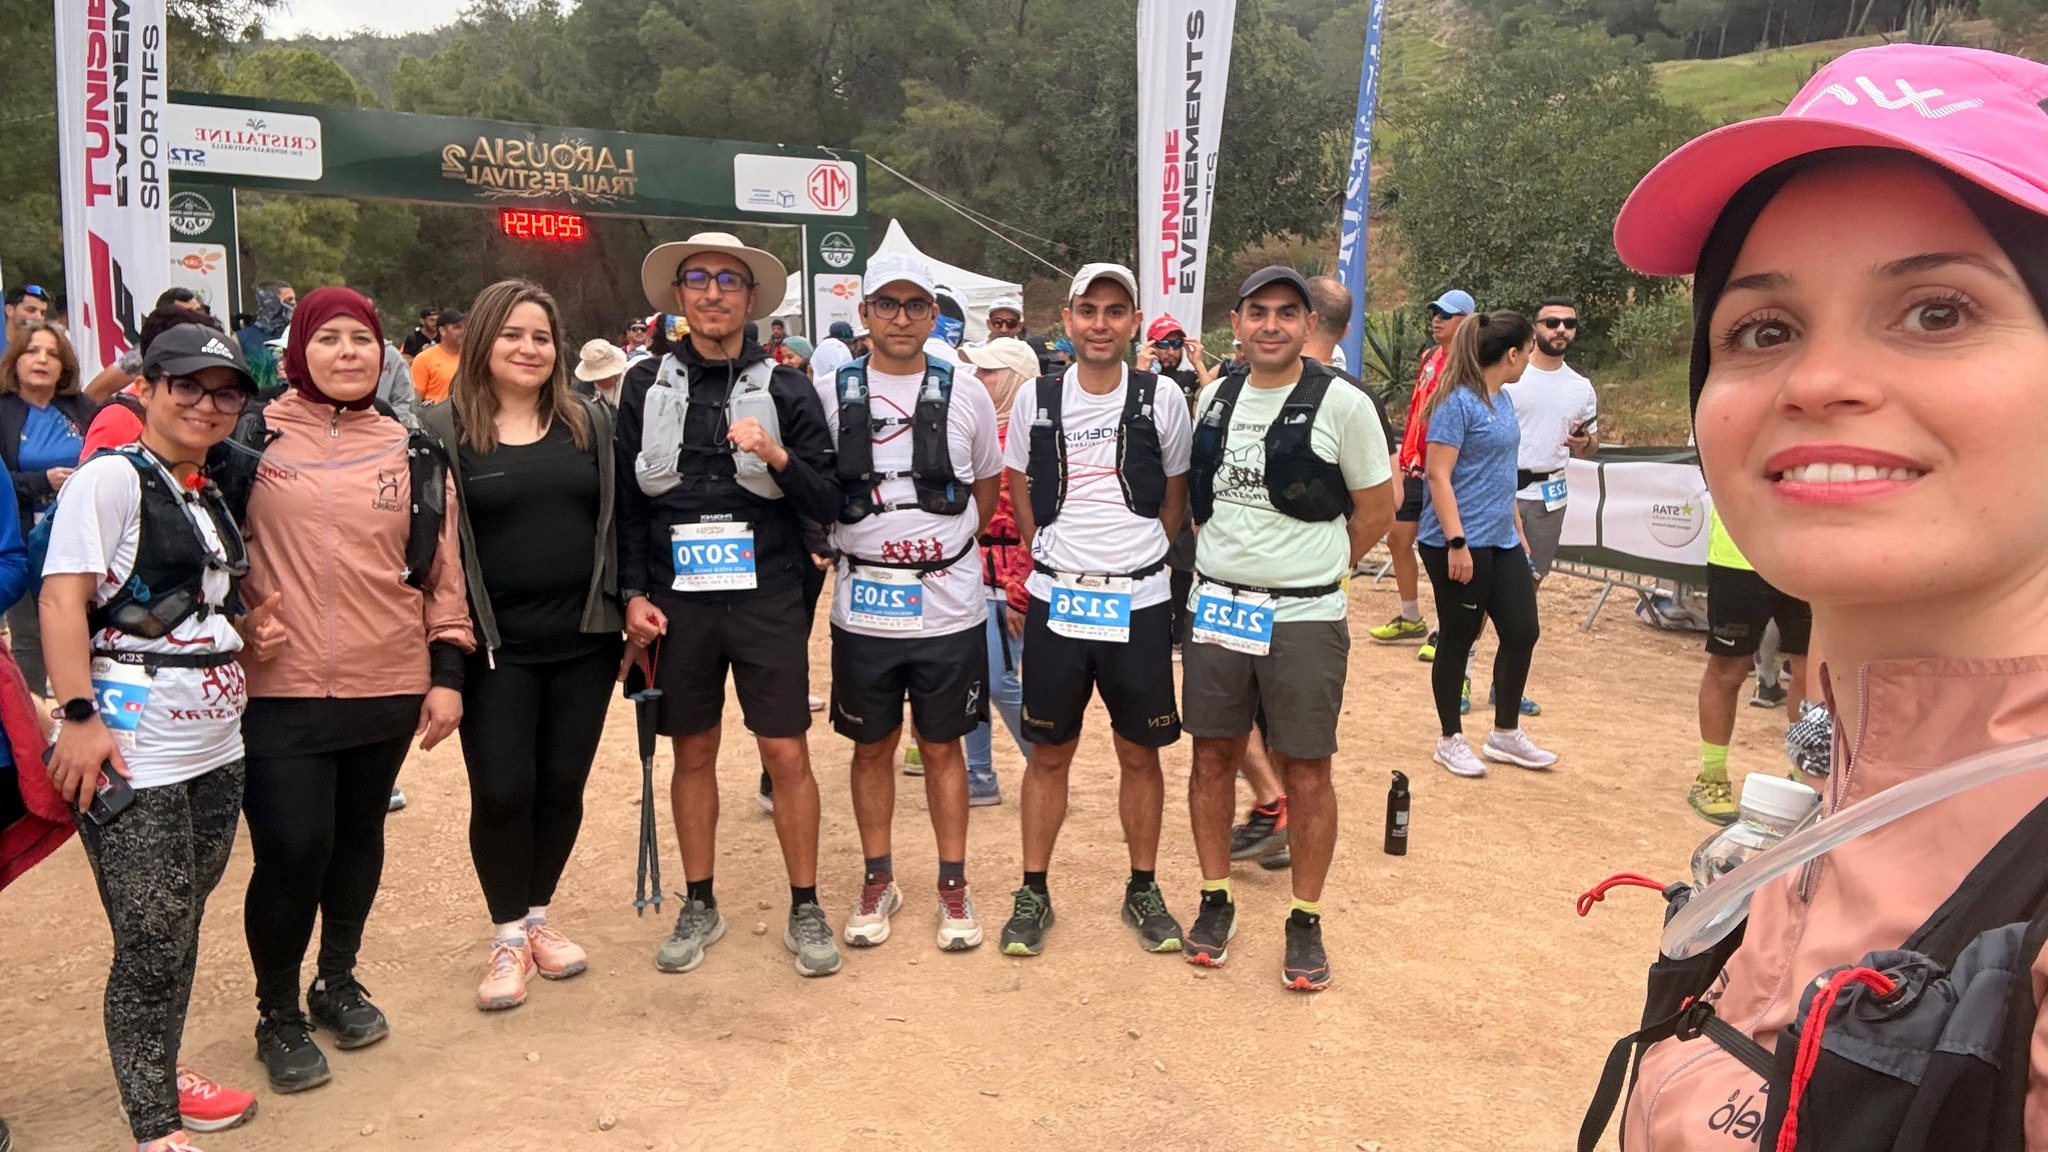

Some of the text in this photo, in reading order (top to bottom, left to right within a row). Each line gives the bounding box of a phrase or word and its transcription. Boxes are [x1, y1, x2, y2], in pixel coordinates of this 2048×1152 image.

[139, 24, 160, 210] SPORTIFS
[1179, 9, 1205, 294] EVENEMENTS
[1162, 128, 1180, 295] TUNISIE
